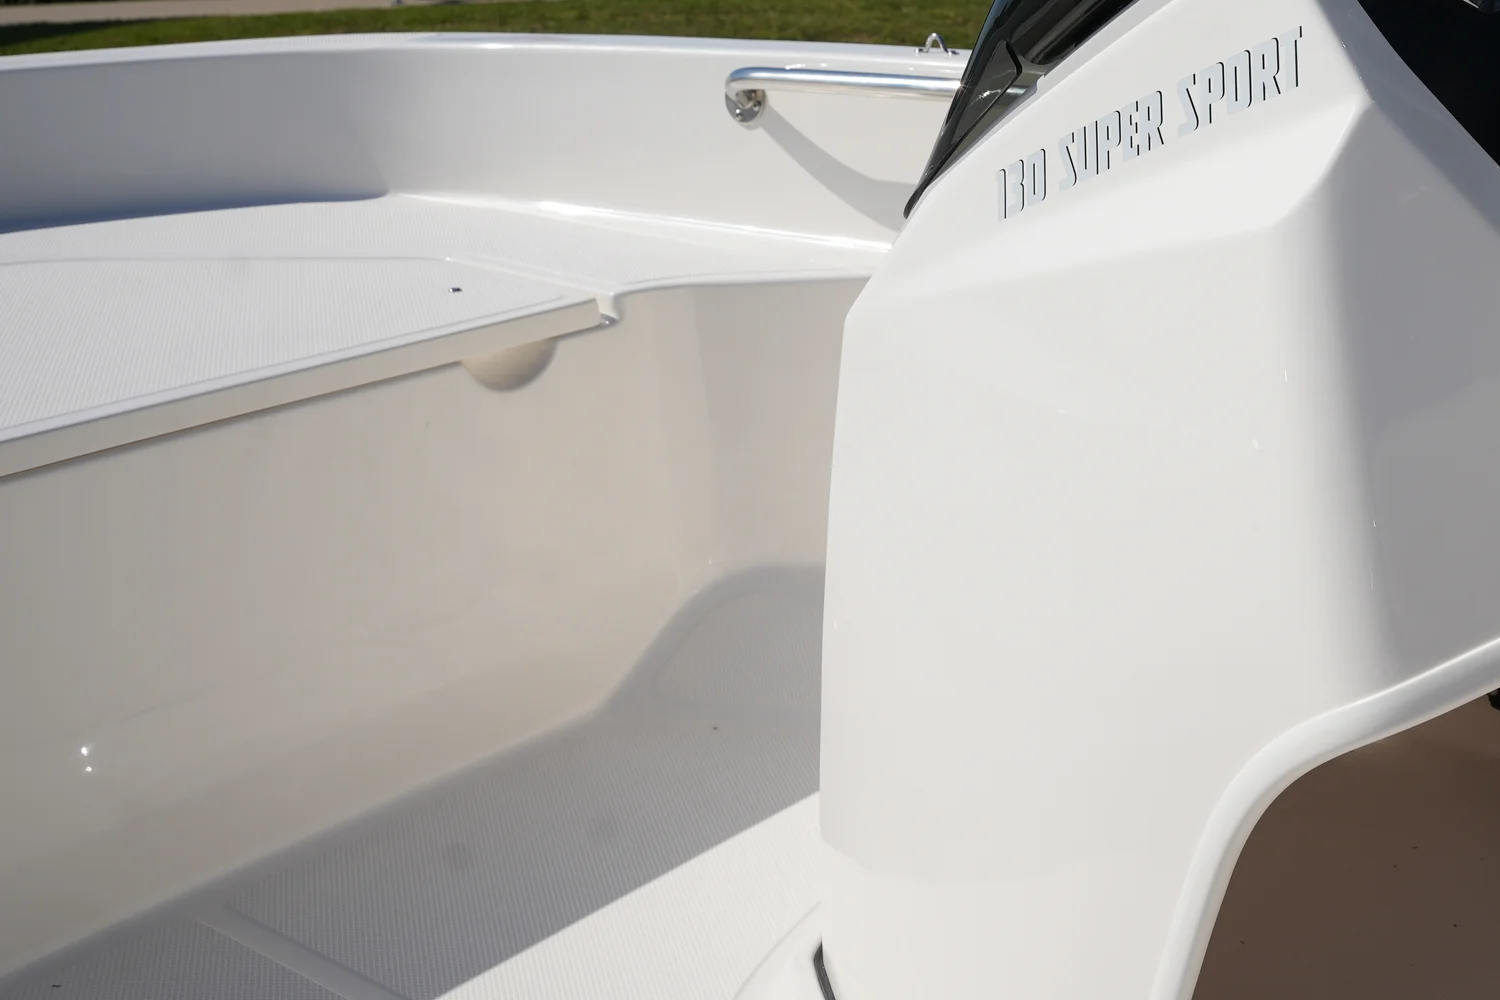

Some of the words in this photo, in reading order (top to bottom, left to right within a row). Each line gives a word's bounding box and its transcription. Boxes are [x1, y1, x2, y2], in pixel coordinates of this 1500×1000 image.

[996, 149, 1046, 220] 130
[1058, 91, 1164, 192] SUPER
[1177, 26, 1303, 137] SPORT
